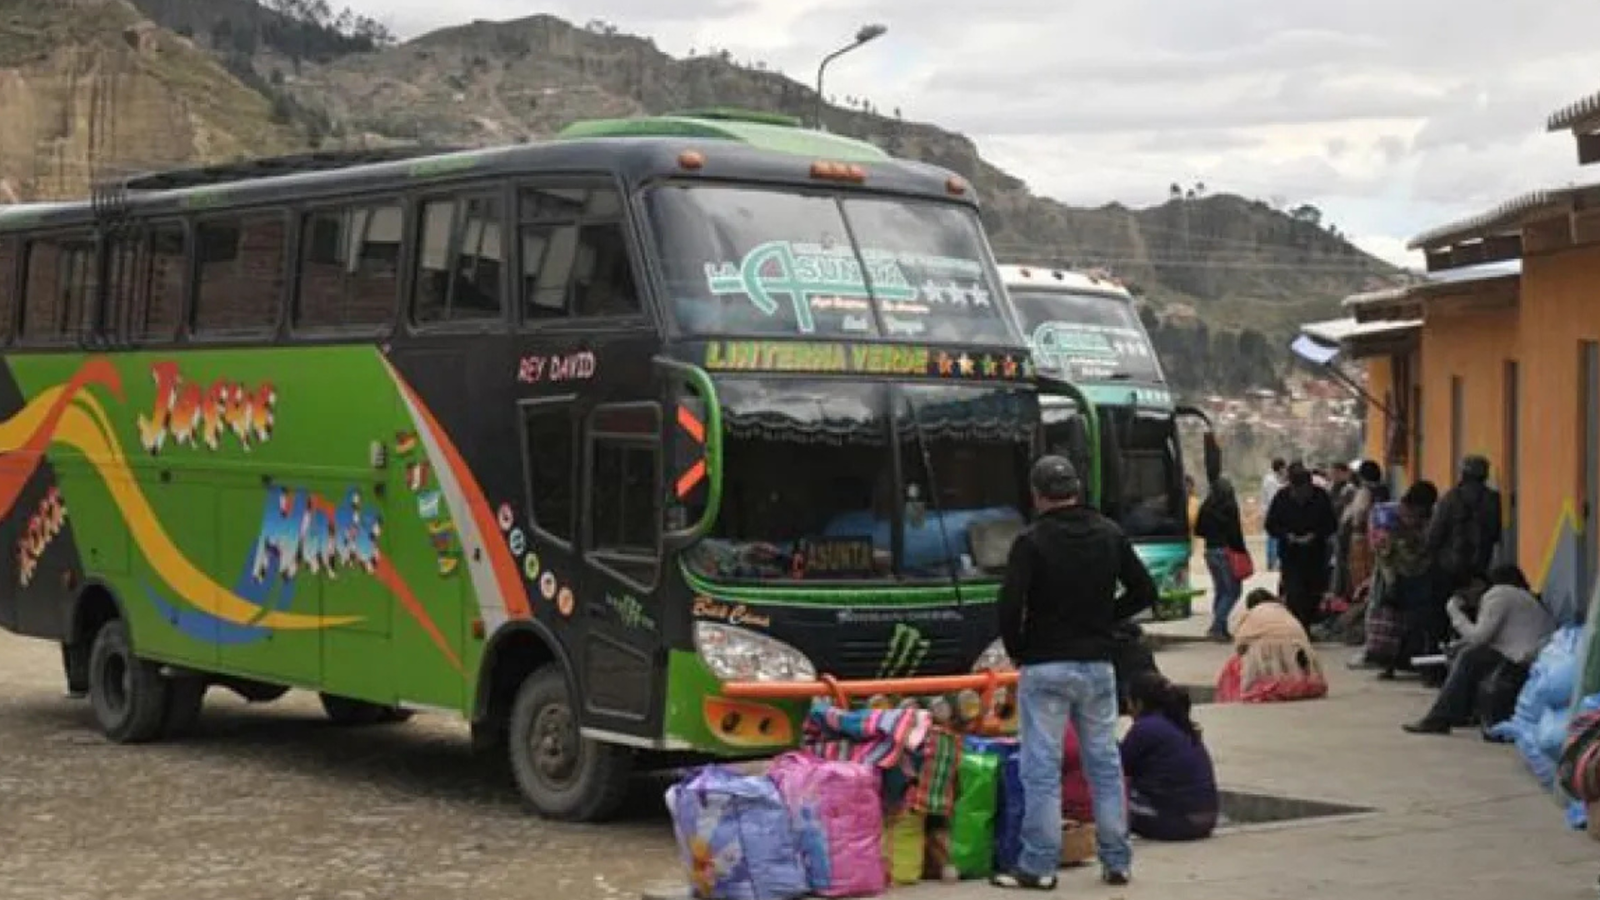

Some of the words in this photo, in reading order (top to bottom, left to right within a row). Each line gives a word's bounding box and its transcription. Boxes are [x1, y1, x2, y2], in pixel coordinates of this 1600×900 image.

[518, 356, 547, 383] REY
[549, 351, 596, 381] DAVID
[852, 343, 929, 373] VERDE
